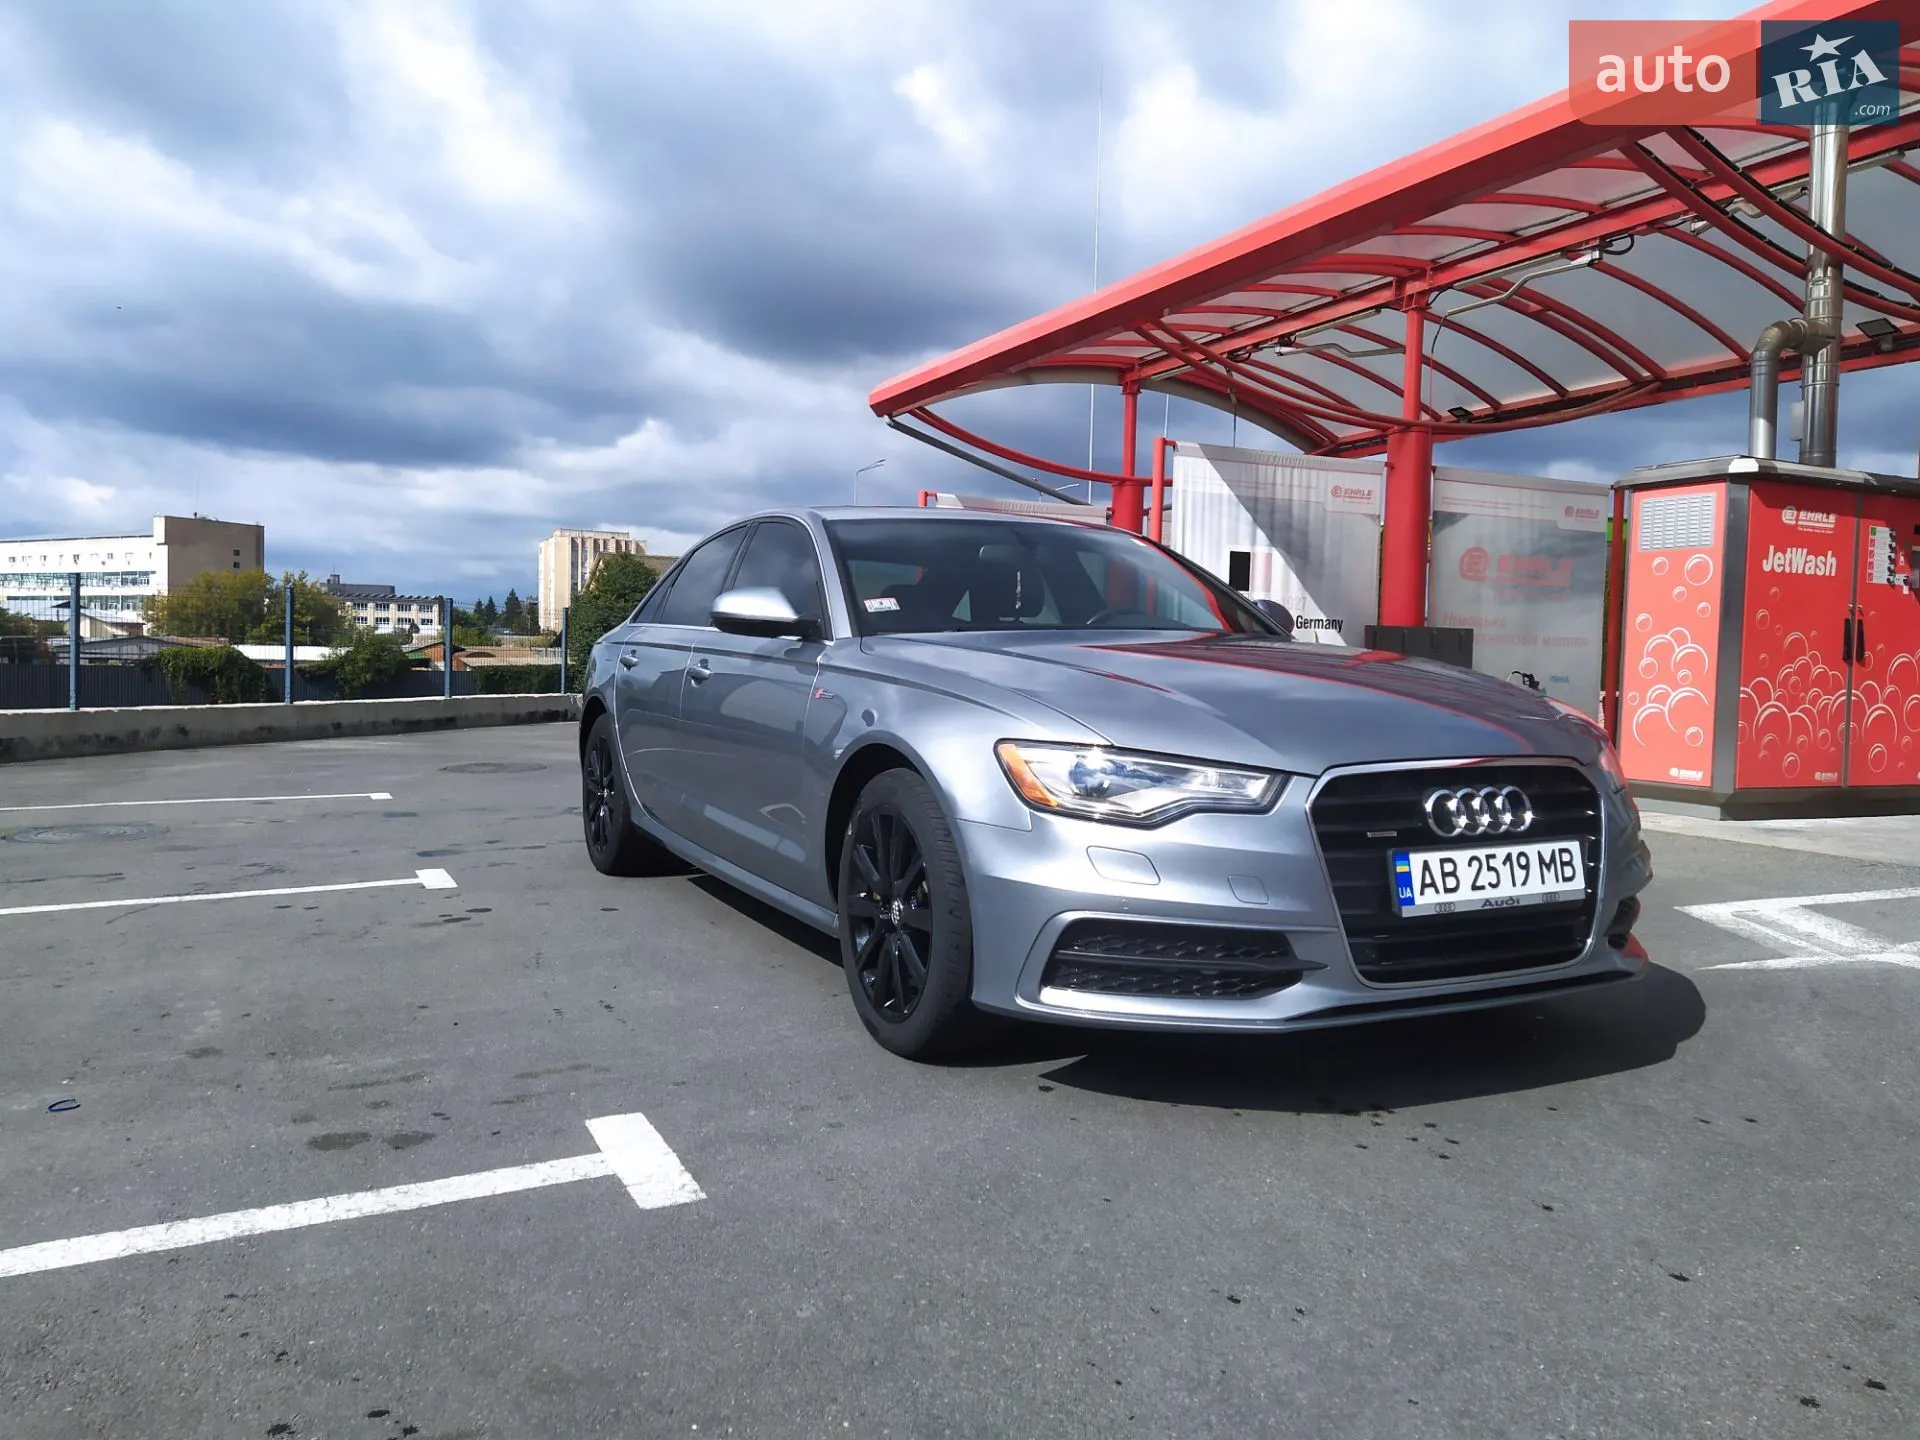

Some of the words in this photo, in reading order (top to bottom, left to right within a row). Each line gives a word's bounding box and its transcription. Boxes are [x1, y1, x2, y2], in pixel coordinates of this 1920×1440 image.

[1762, 545, 1837, 577] JetWash
[1295, 614, 1344, 634] Germany
[1419, 857, 1460, 896] AB
[1467, 851, 1531, 891] 2519
[1538, 847, 1576, 885] MB
[1398, 887, 1413, 899] UA
[1481, 897, 1521, 909] Audi
